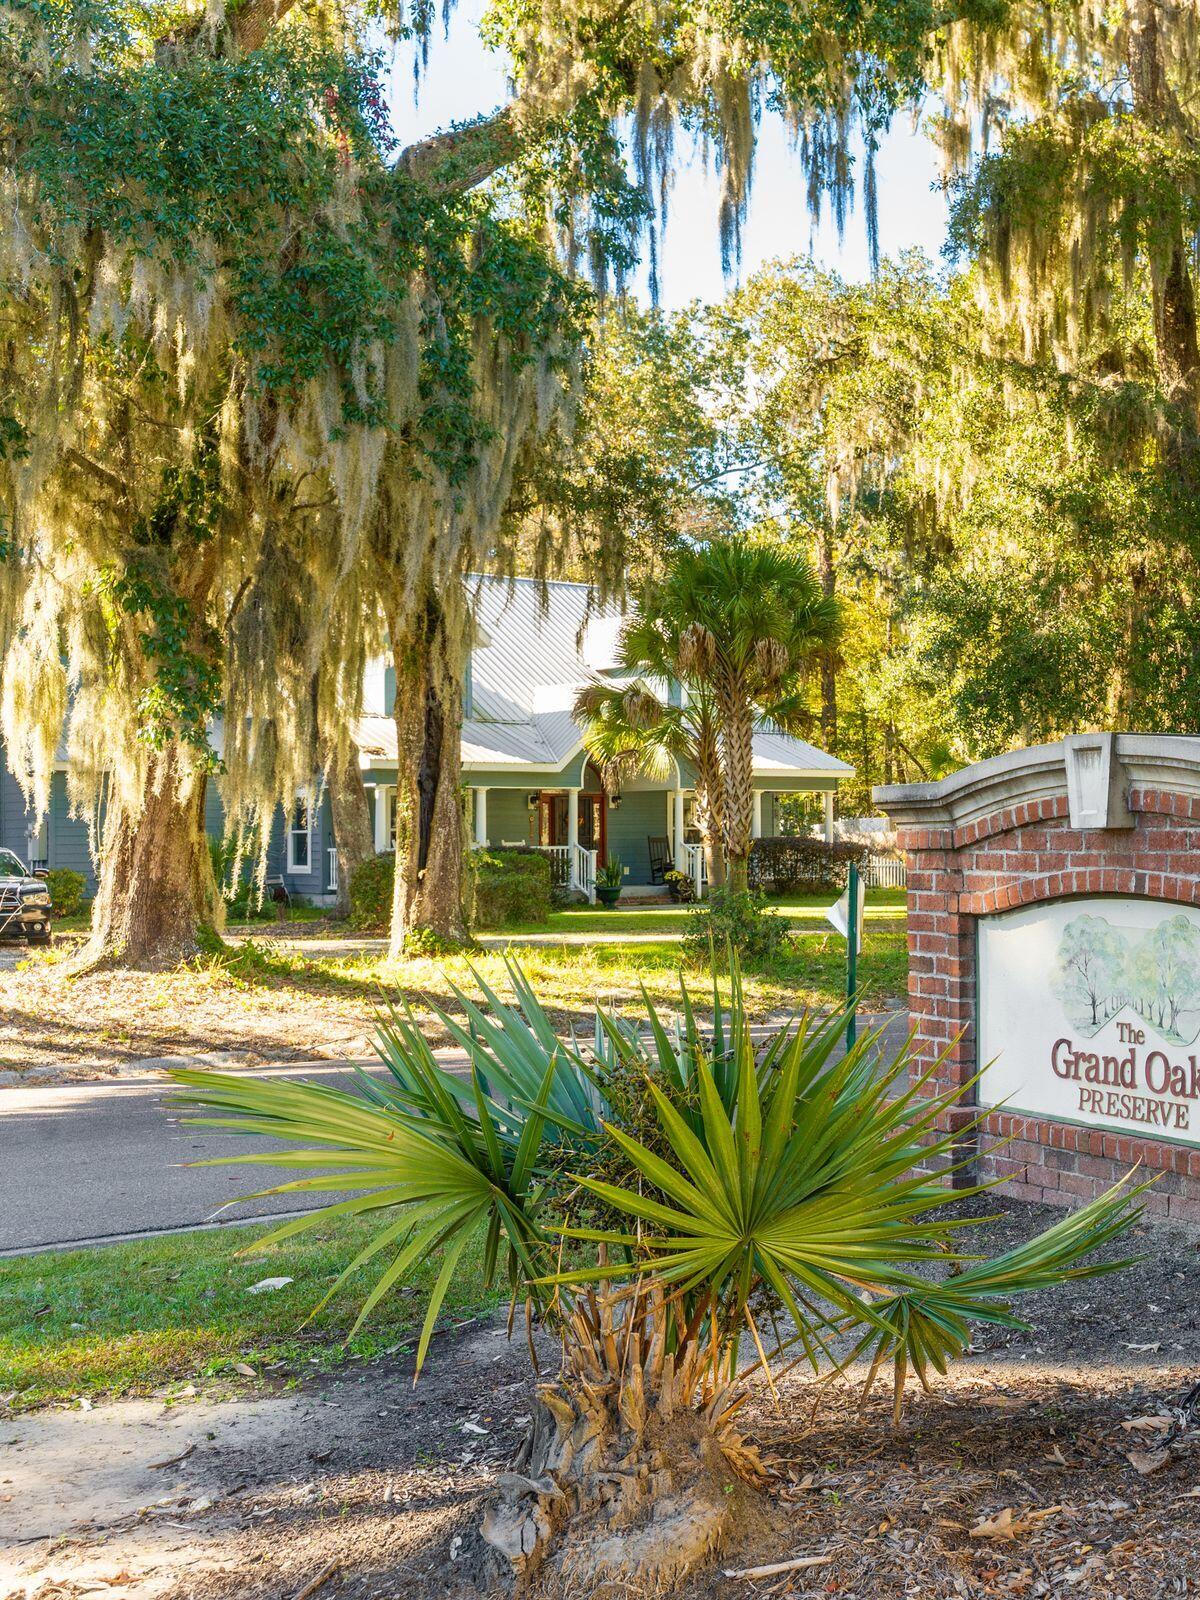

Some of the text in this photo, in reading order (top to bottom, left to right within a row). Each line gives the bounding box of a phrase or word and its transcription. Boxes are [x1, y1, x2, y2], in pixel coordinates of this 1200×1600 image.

[1116, 1022, 1145, 1045] The
[1051, 1038, 1138, 1090] Grand
[1078, 1087, 1190, 1130] PRESERVE
